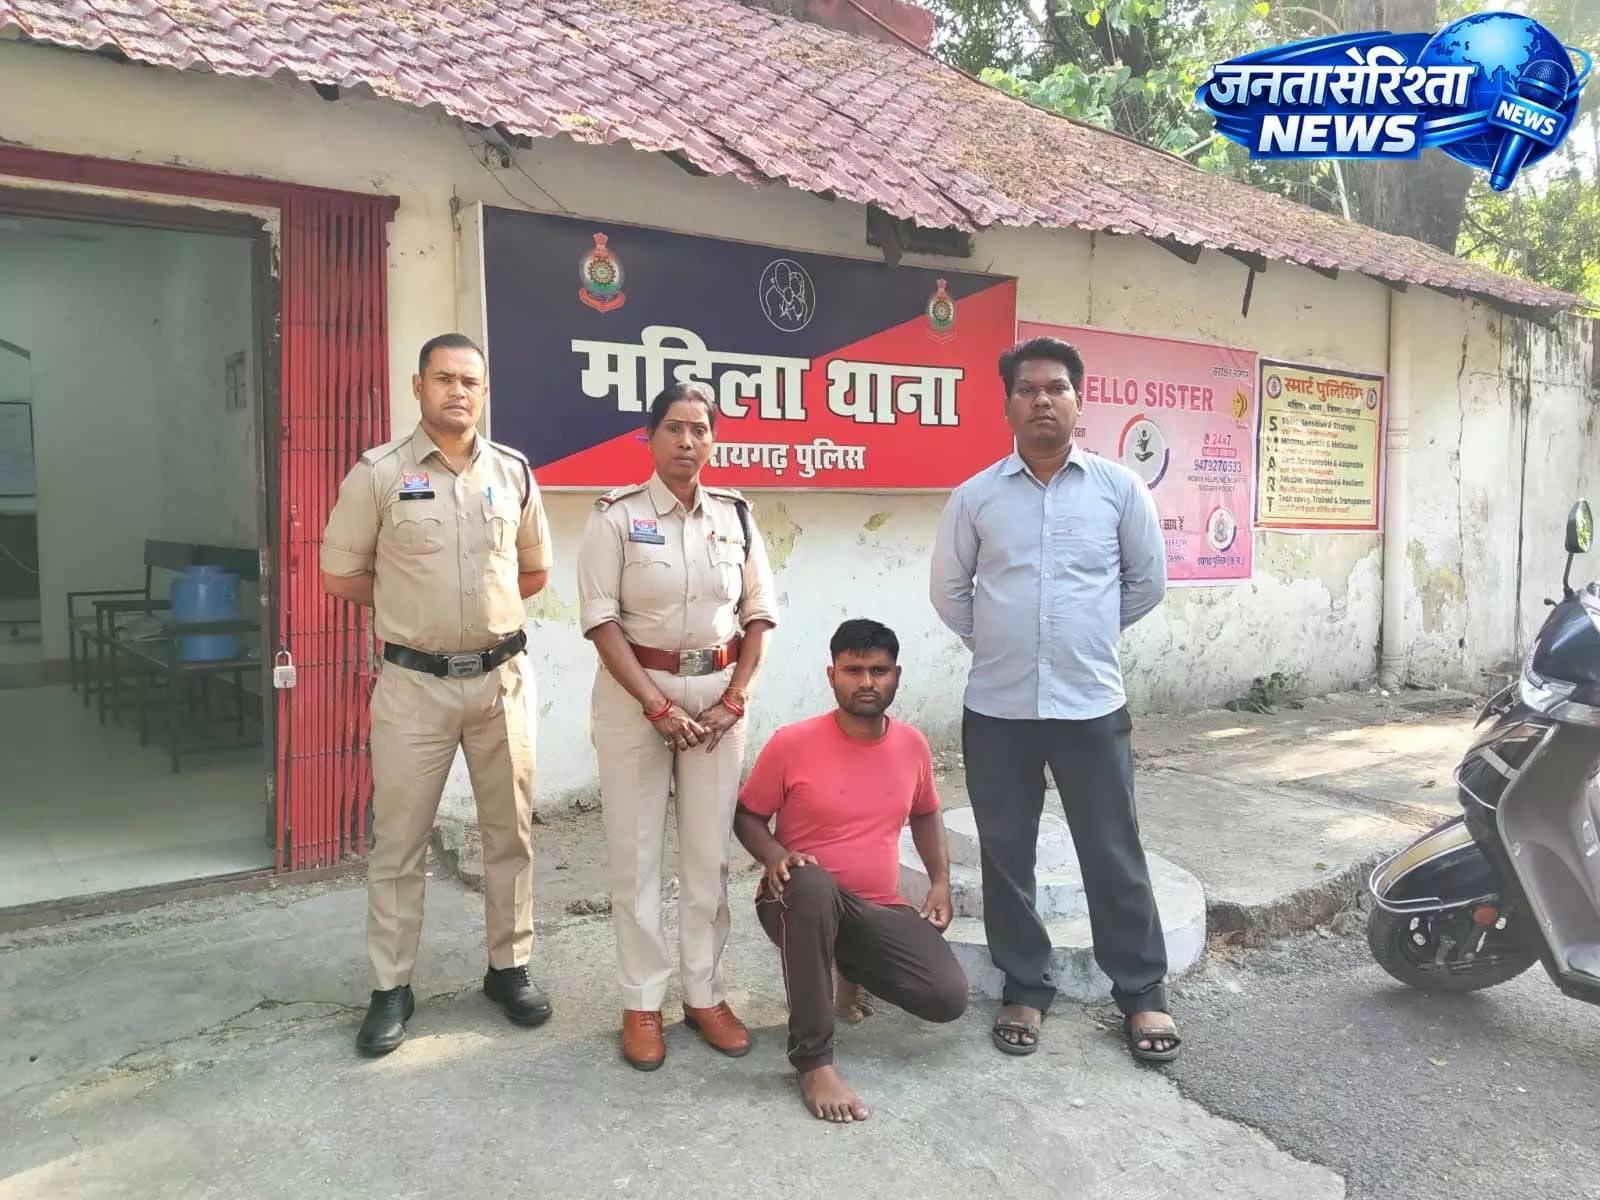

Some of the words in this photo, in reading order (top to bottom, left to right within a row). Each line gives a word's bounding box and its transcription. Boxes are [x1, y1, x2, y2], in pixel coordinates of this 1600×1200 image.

[570, 324, 811, 421] महिला
[825, 358, 965, 427] थाना
[1080, 375, 1138, 406] ELLO
[1144, 381, 1214, 412] SISTER
[709, 440, 788, 476] रायगढ़
[793, 437, 866, 479] पुलिस
